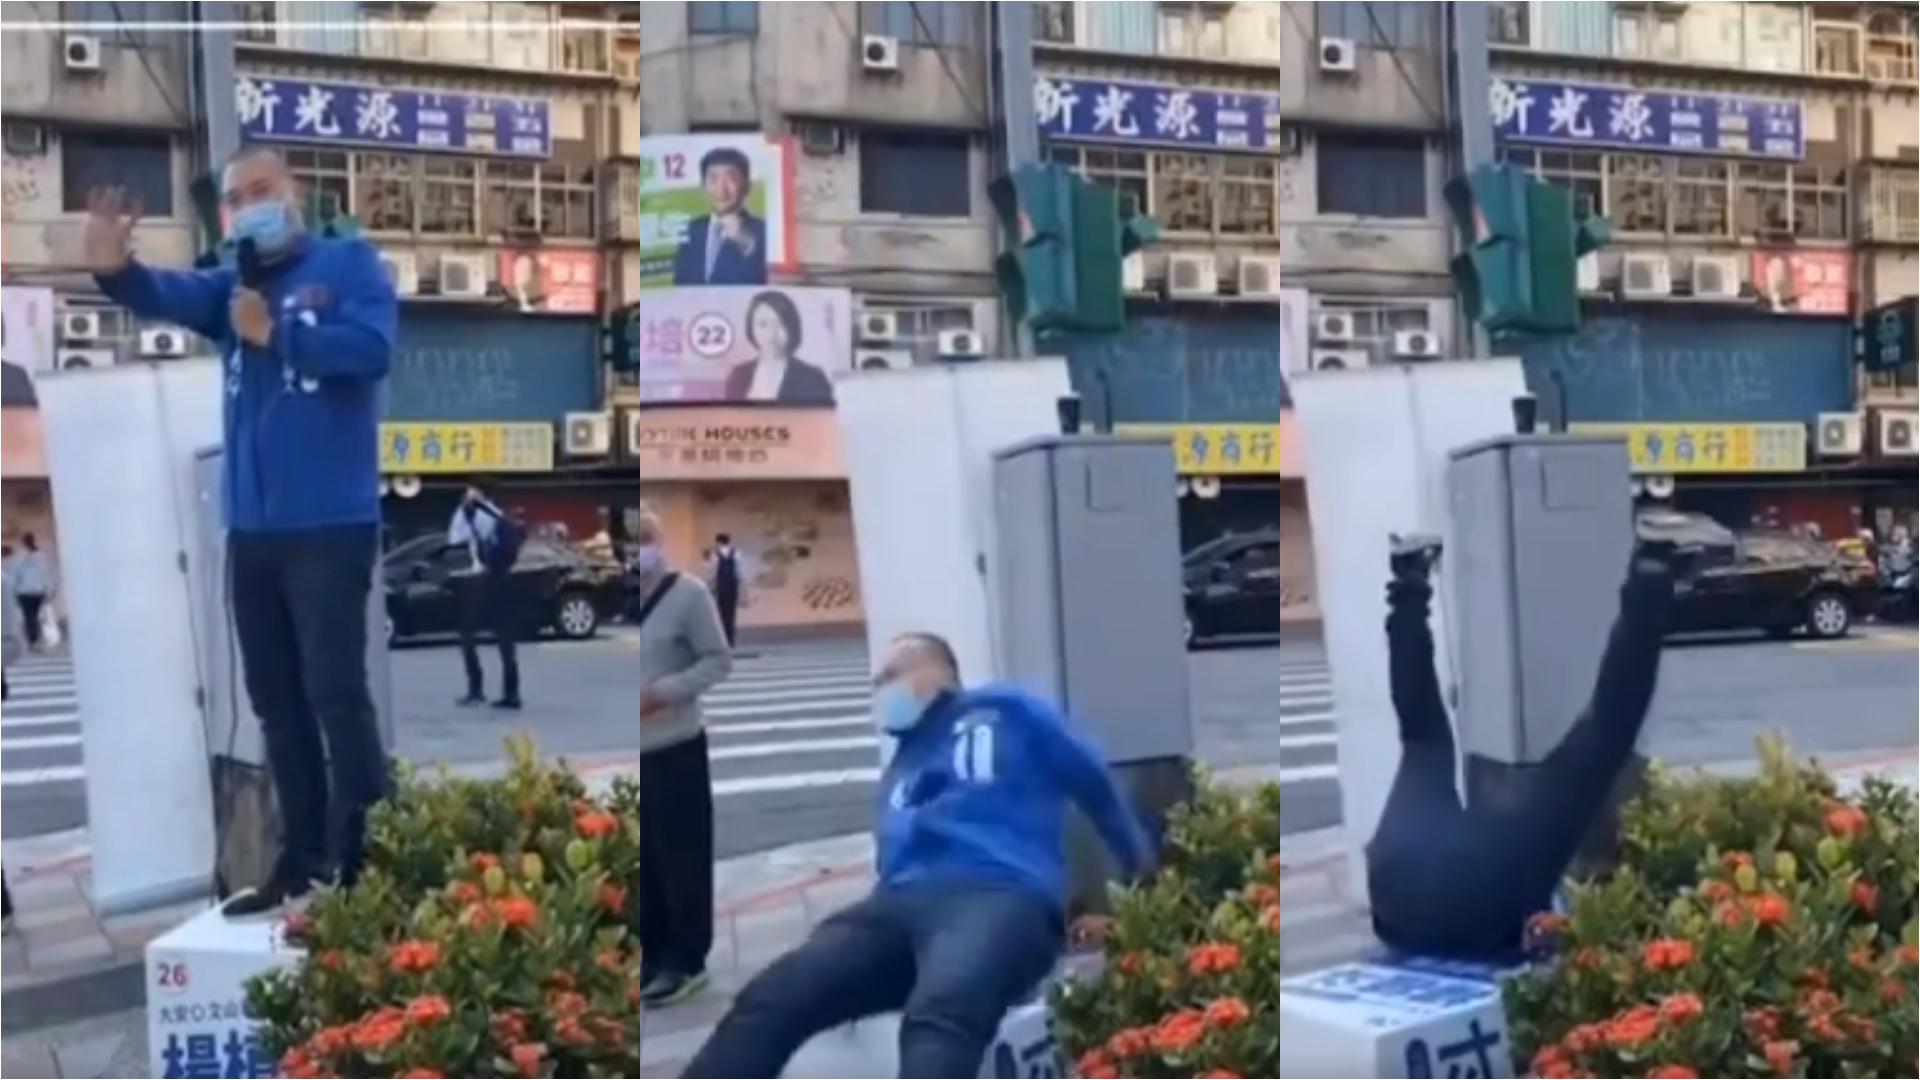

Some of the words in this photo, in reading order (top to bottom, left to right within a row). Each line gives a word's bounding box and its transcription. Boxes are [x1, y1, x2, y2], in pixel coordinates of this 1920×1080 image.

[663, 154, 687, 178] 12
[697, 326, 727, 346] 22
[158, 964, 188, 987] 26
